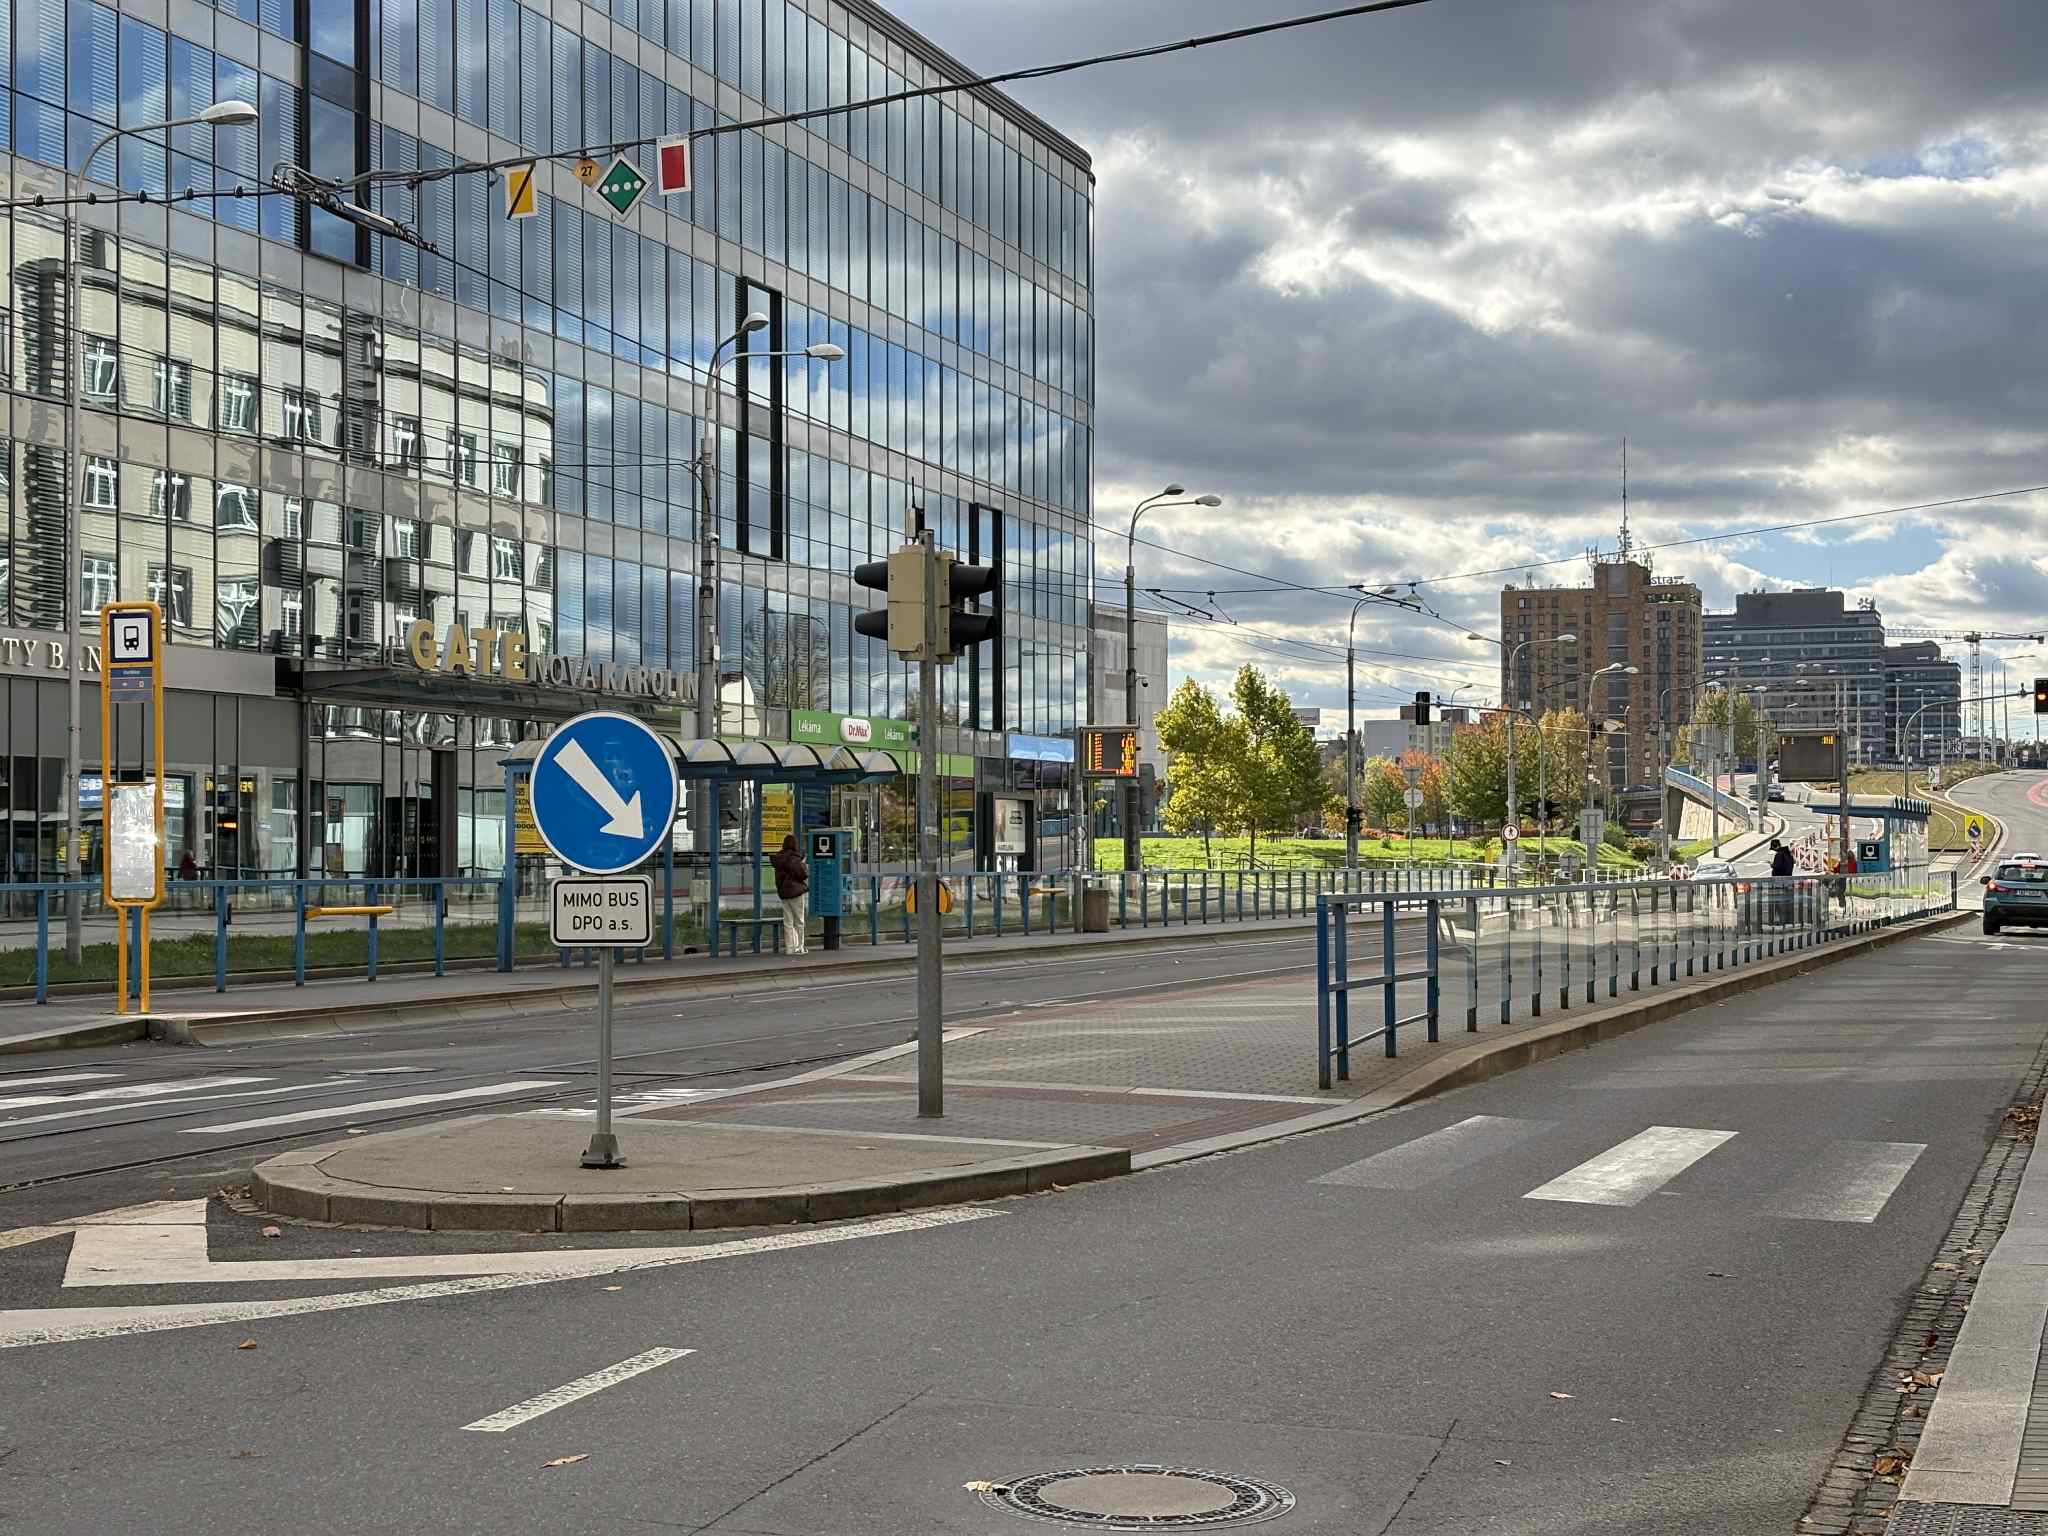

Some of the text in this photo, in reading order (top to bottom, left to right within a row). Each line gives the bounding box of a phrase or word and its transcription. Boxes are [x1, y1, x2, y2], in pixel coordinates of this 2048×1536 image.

[581, 165, 593, 177] 27
[405, 619, 525, 680] GATE
[563, 892, 639, 907] MIMO BUS
[572, 915, 633, 930] DPO a.s.
